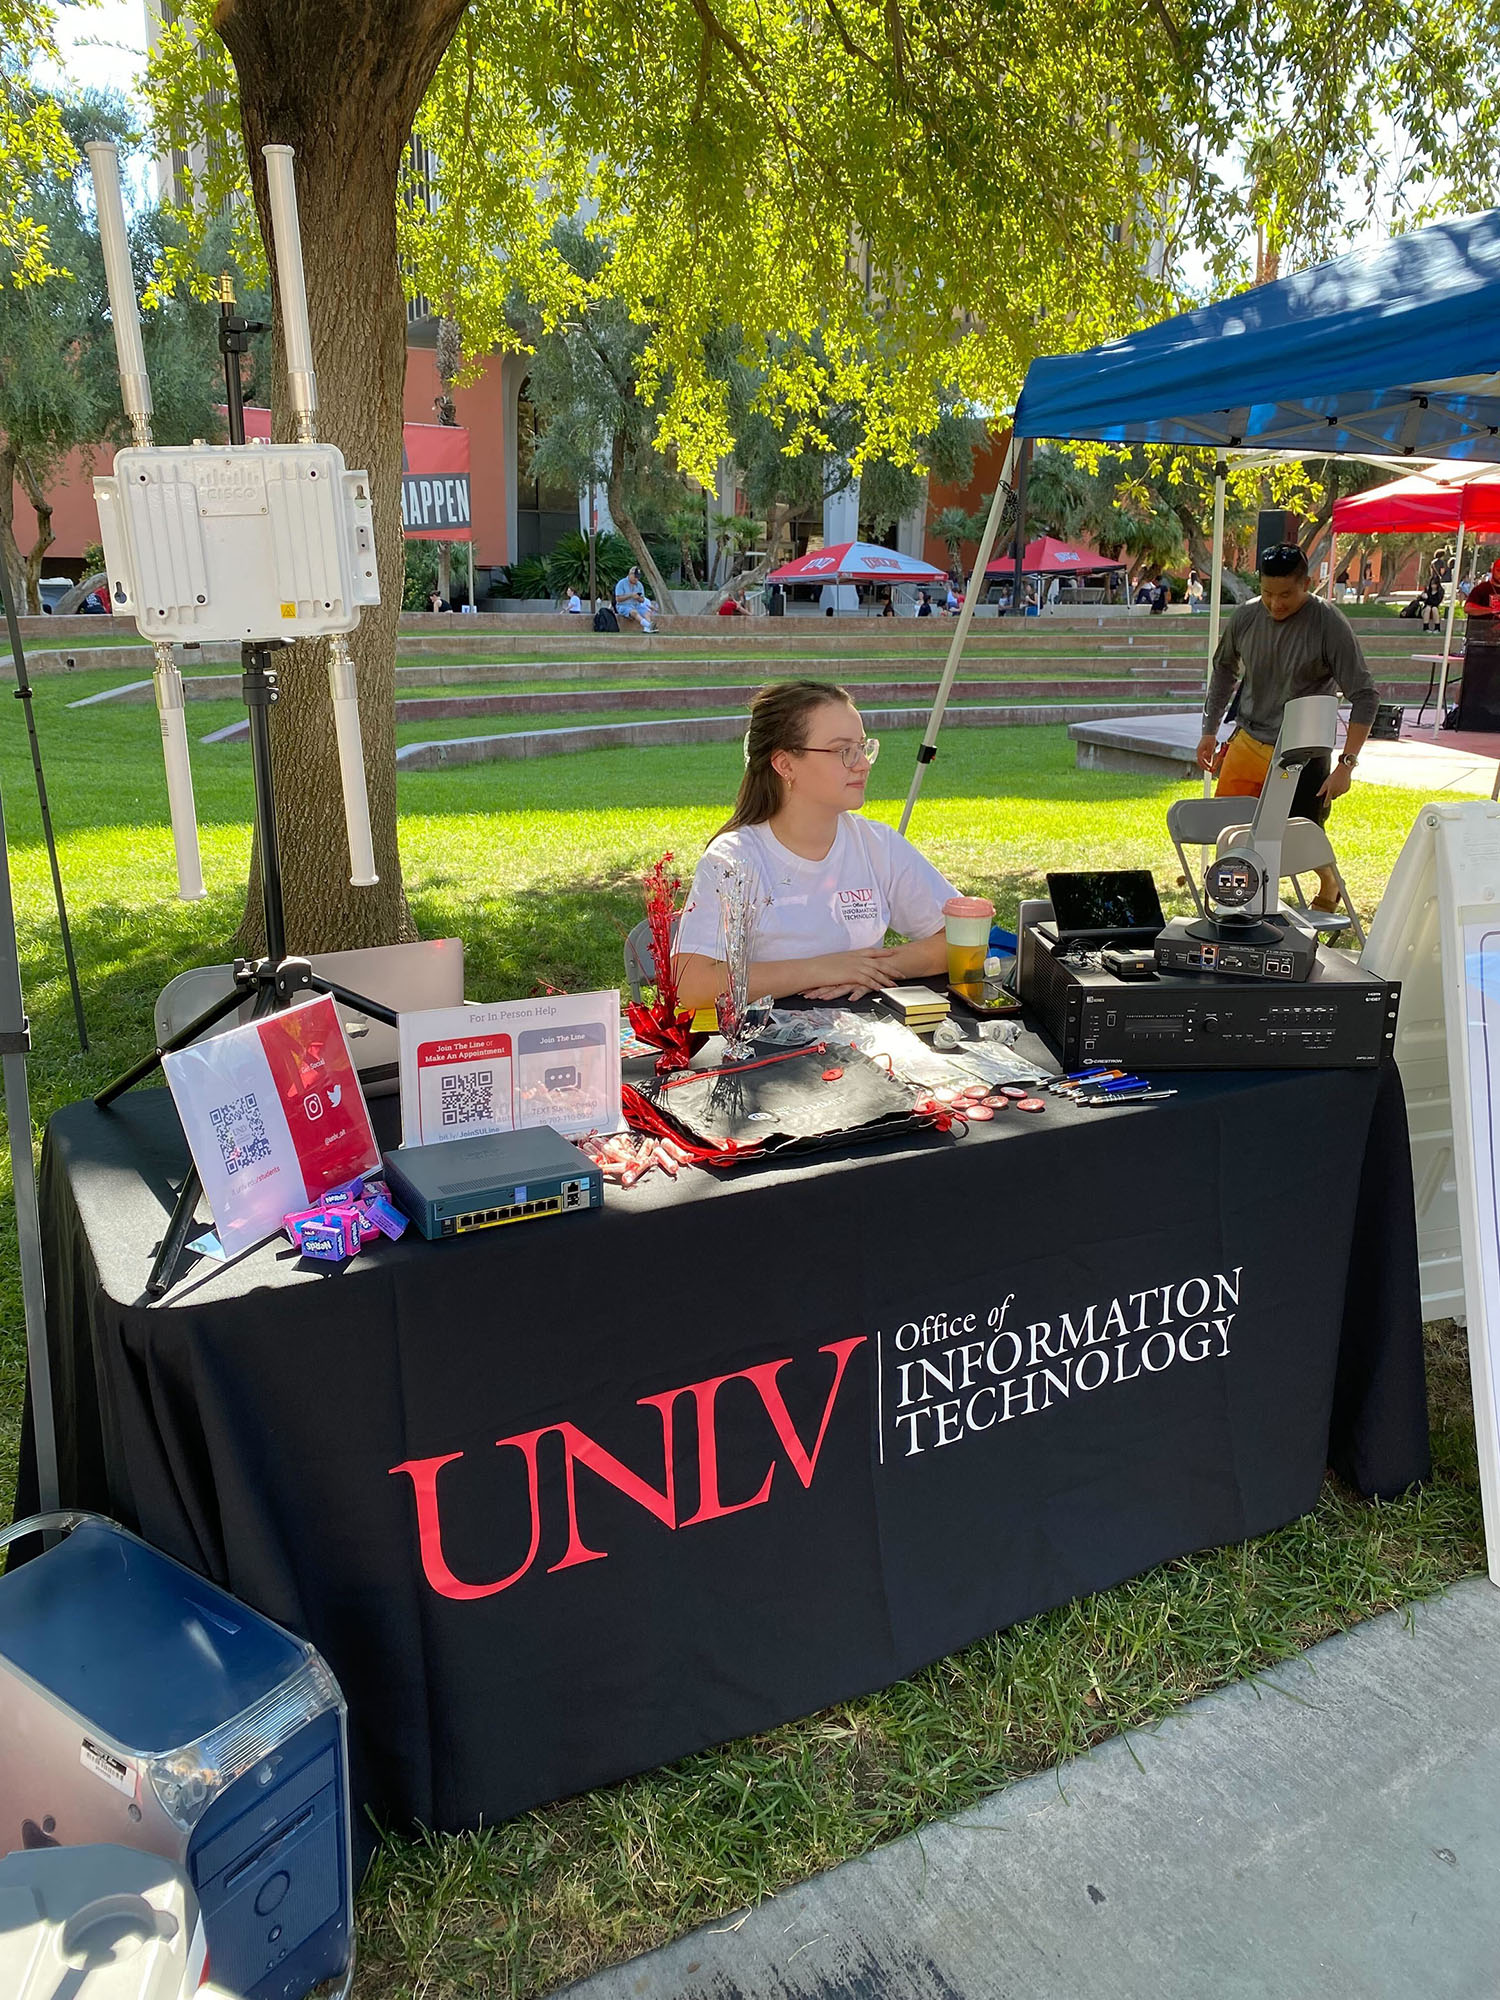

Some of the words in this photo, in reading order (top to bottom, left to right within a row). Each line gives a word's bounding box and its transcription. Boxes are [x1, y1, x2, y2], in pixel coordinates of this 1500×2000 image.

[838, 888, 873, 904] UNLV
[469, 1014, 486, 1023] For
[487, 1012, 499, 1021] In
[500, 1008, 533, 1020] Person
[534, 1006, 557, 1018] Help
[436, 1045, 452, 1053] Join
[453, 1042, 468, 1051] The
[469, 1040, 485, 1049] Line
[539, 1037, 555, 1045] Join
[556, 1034, 569, 1042] The
[570, 1033, 586, 1041] Line
[425, 1054, 445, 1063] Make
[446, 1052, 457, 1060] An
[458, 1047, 505, 1060] Appointment
[310, 1058, 326, 1070] Social
[894, 1313, 978, 1352] Office
[986, 1294, 1015, 1334] of
[895, 1267, 1243, 1409] INFORMATION
[895, 1313, 1237, 1457] TECHNOLOGY
[388, 1334, 867, 1600] UNLV
